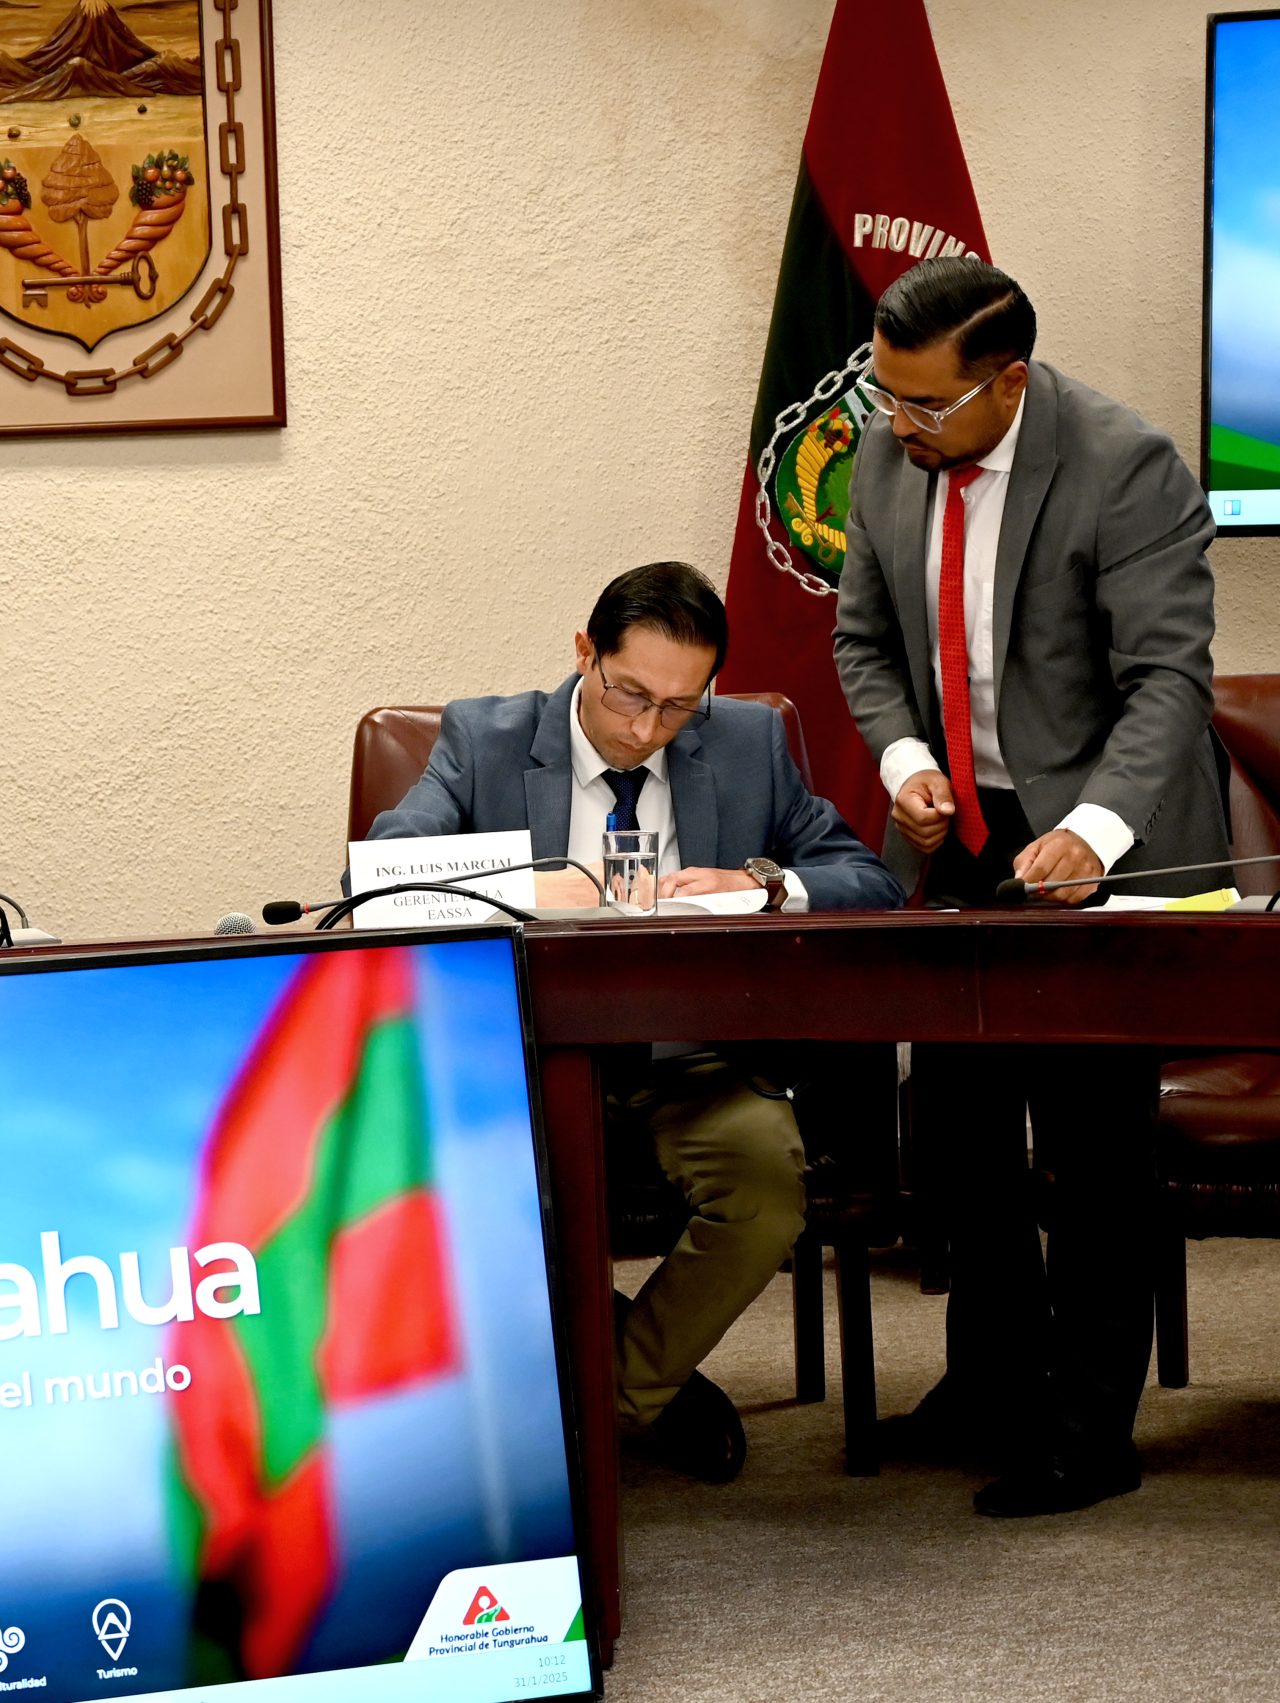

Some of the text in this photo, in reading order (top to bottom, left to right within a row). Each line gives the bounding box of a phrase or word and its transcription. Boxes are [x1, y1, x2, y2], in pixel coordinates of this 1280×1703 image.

[853, 213, 981, 260] PROVIN
[376, 866, 406, 877] ING.
[410, 862, 443, 875] LUIS
[393, 892, 459, 907] GERENTE
[428, 907, 473, 921] EASSA
[44, 1356, 192, 1405] mundo
[440, 1625, 535, 1643] Honorable Gobierno
[429, 1634, 549, 1656] Provincial de Tungurahua
[96, 1666, 138, 1681] Turismo
[514, 1671, 568, 1688] 31/1/2025
